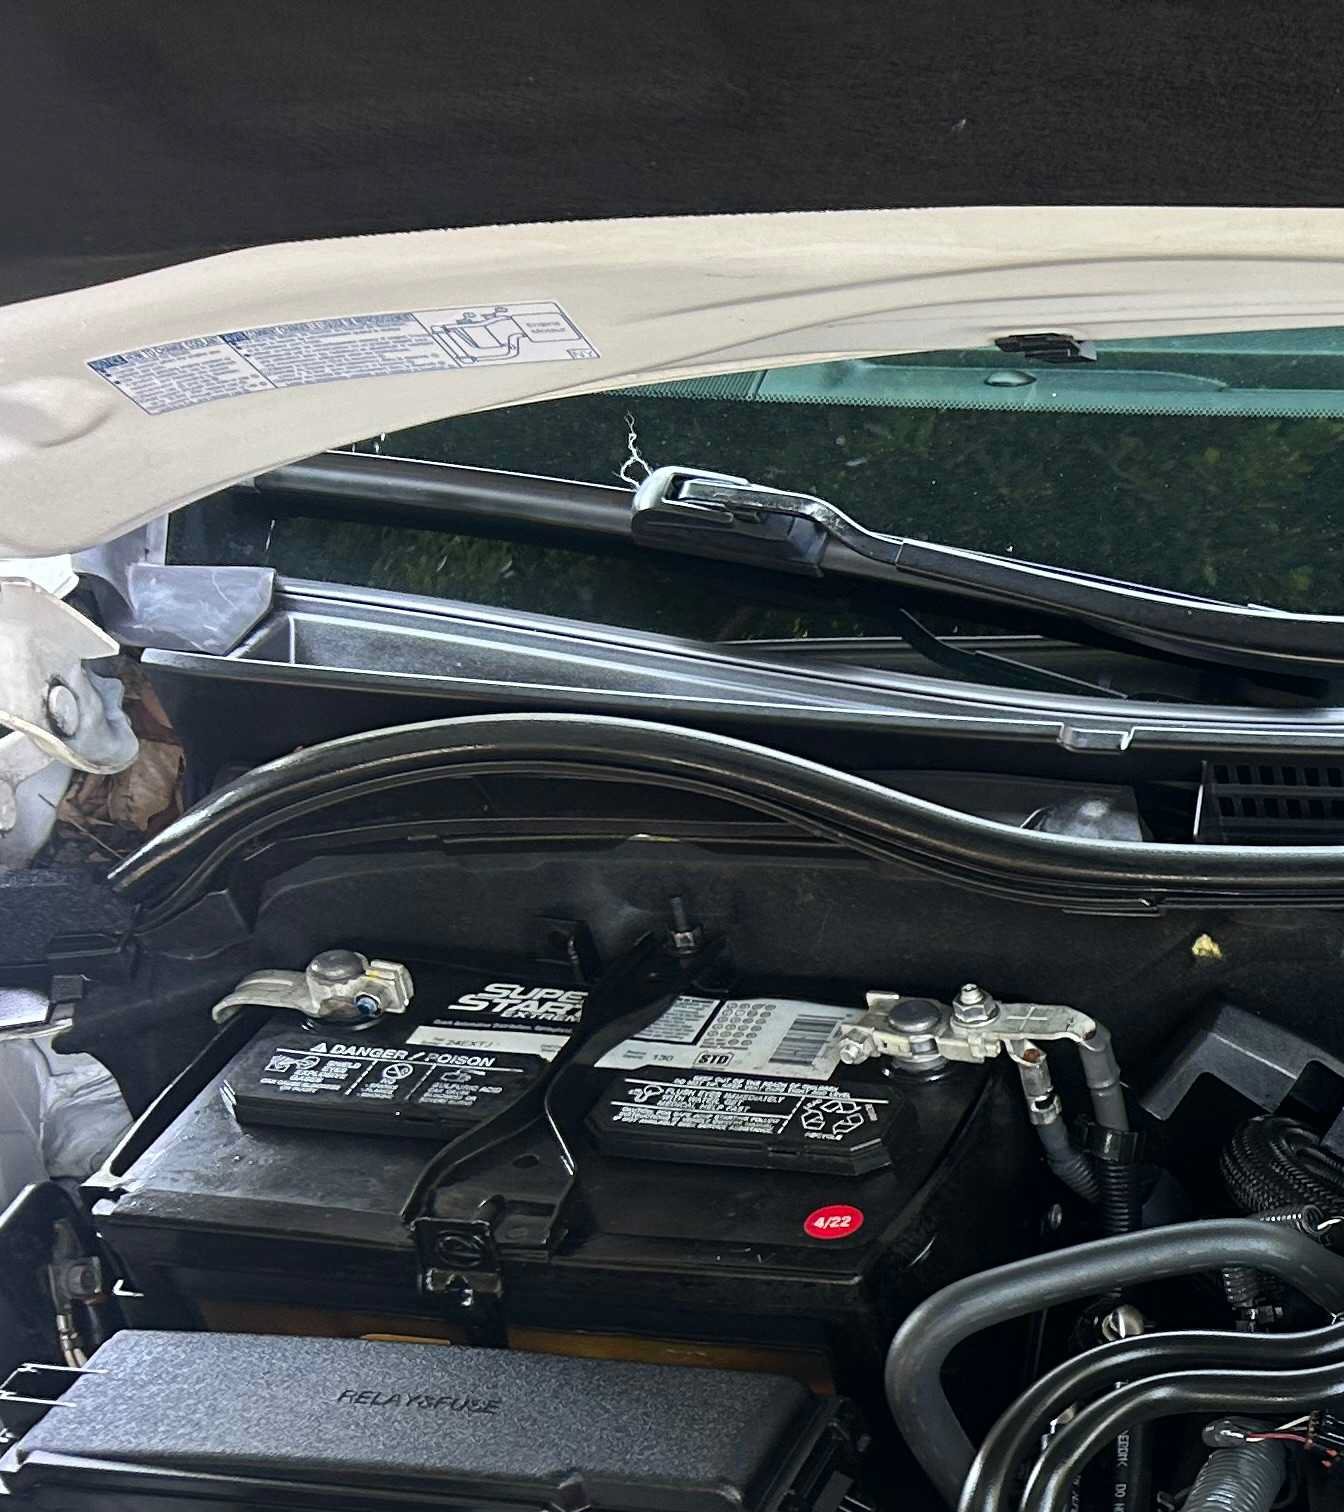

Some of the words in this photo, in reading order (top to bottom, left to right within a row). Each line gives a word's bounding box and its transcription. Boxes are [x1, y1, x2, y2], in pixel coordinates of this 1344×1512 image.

[478, 983, 588, 1003] SUPE
[448, 994, 582, 1013] STAR
[501, 1011, 581, 1022] EXTREM
[330, 1044, 408, 1060] DANGER
[425, 1052, 496, 1067] POISON
[700, 1054, 728, 1064] STD
[814, 1215, 850, 1230] 4/22
[337, 1390, 501, 1414] RELAY&FUSE
[1114, 1484, 1127, 1498] DO
